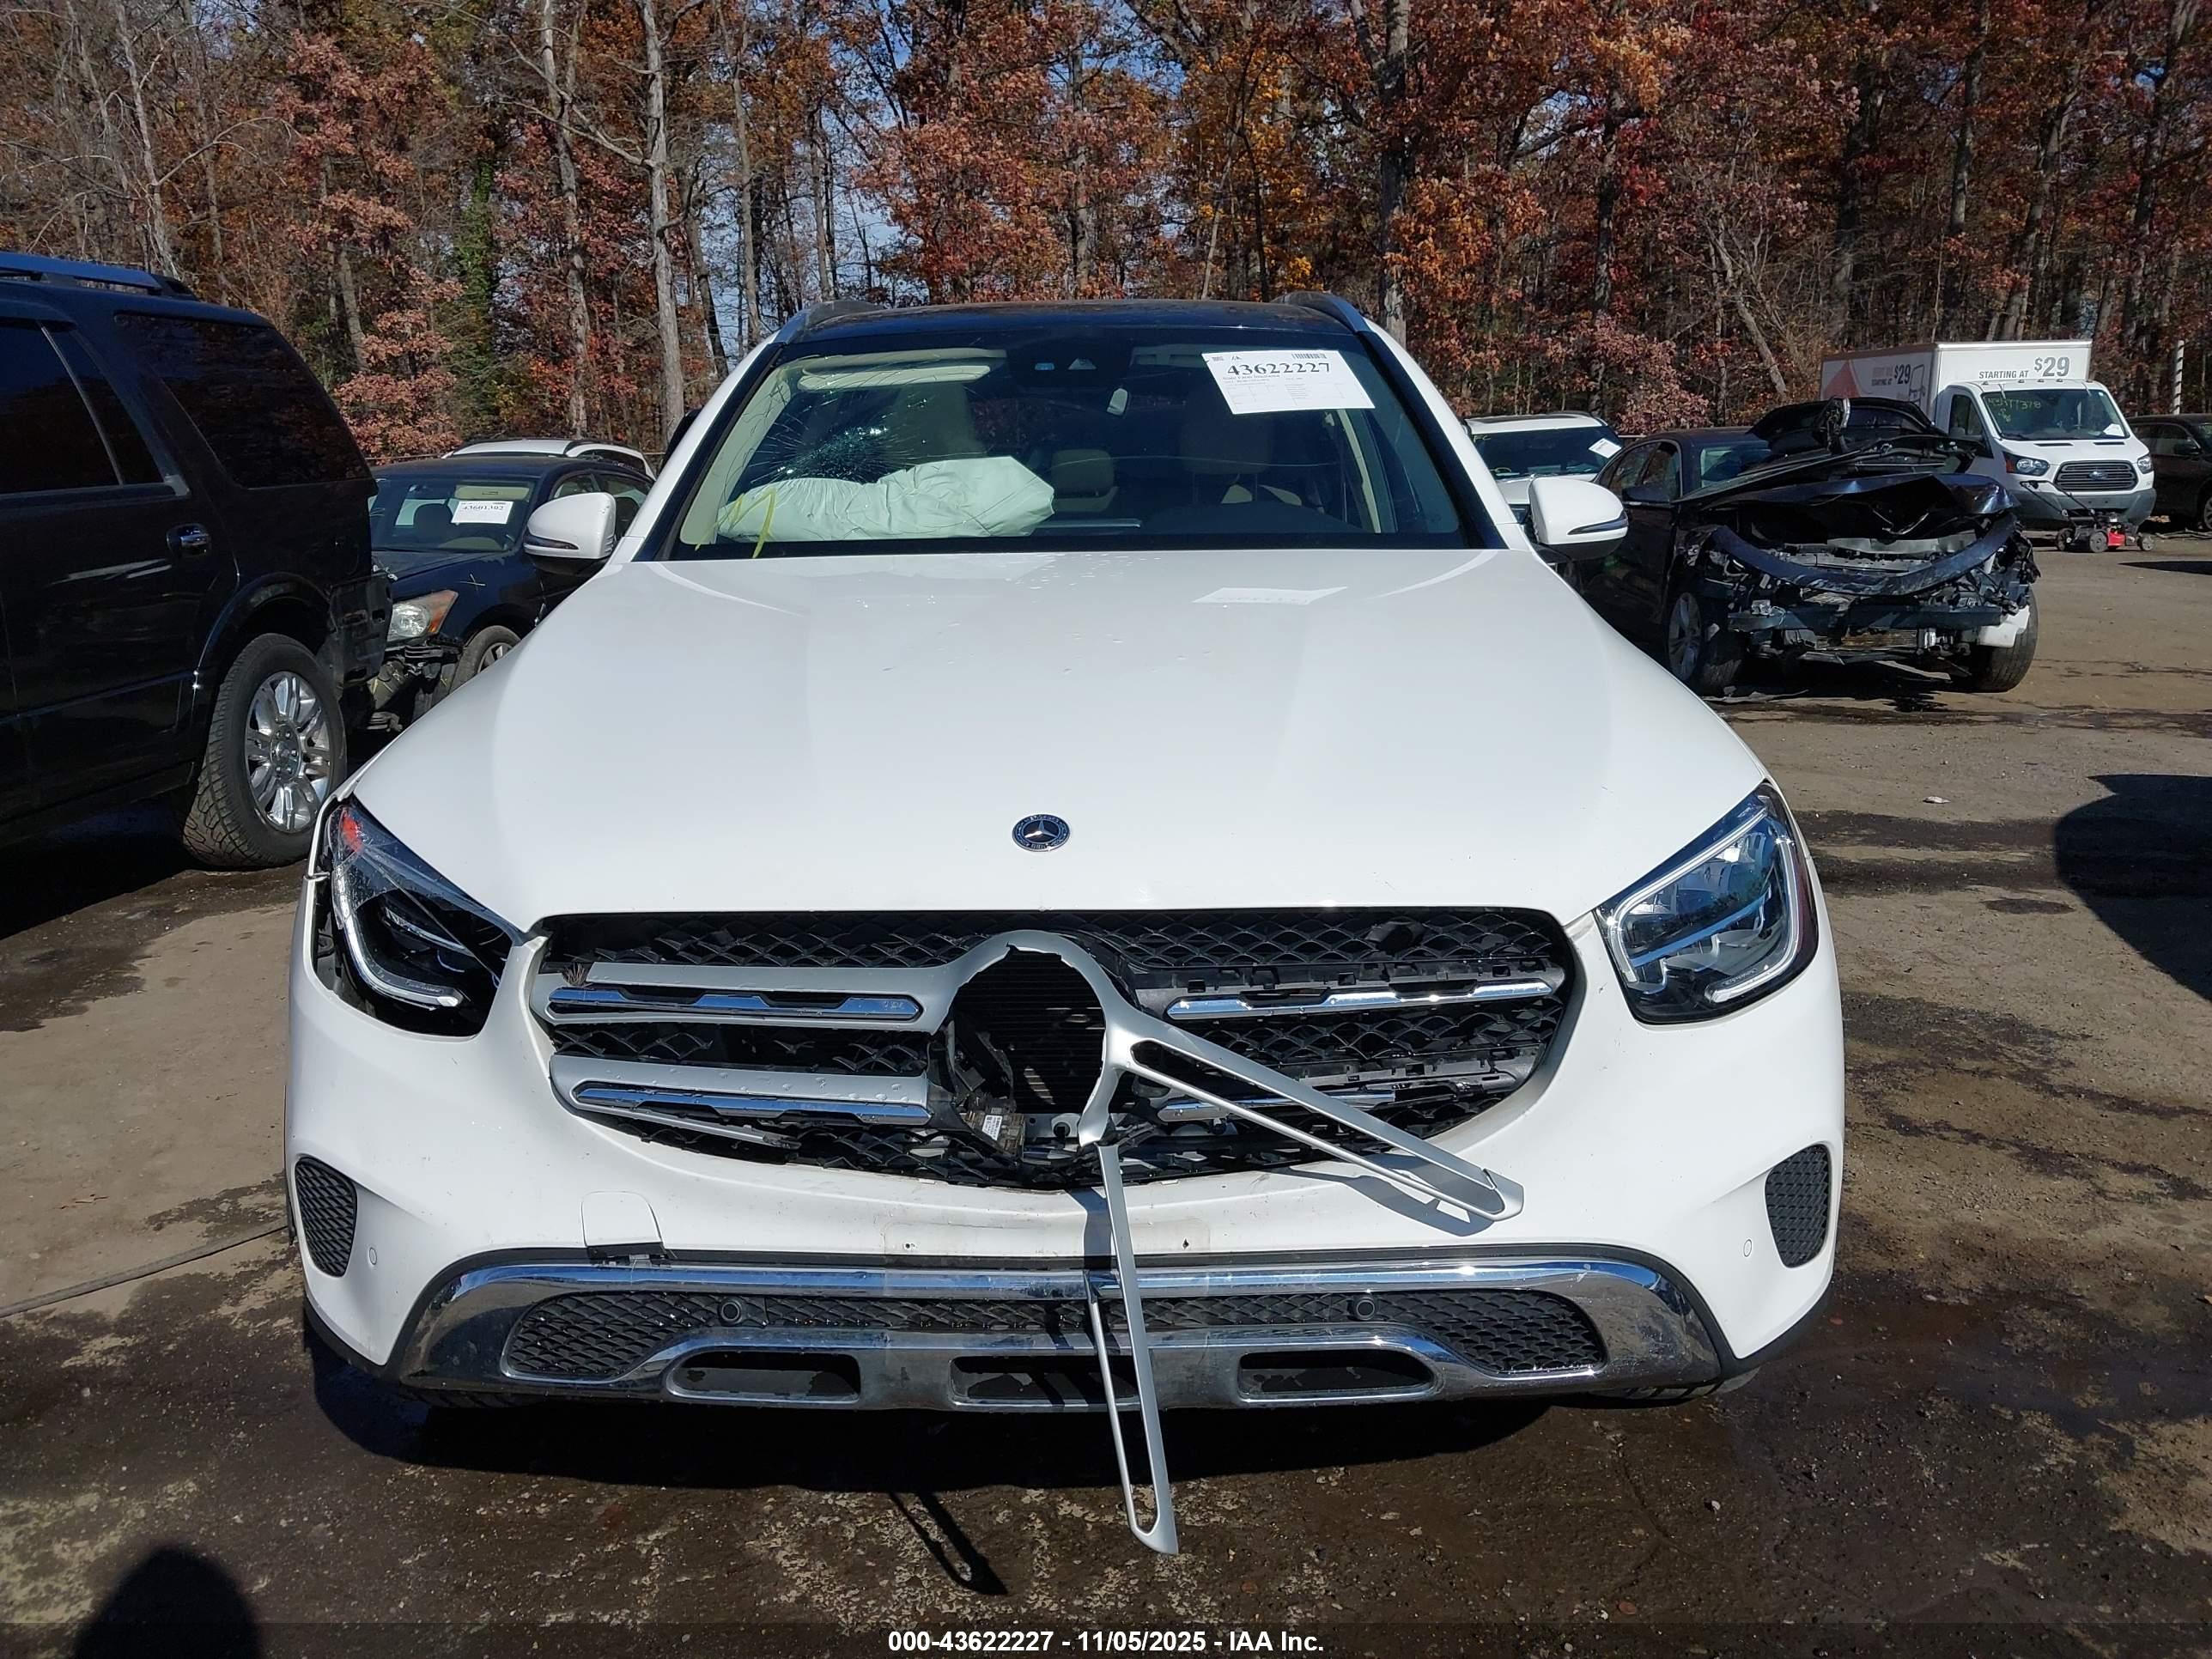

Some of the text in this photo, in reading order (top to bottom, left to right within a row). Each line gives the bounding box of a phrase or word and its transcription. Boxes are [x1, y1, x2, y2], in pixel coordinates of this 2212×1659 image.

[1227, 362, 1330, 375] 43622227
[1893, 363, 1911, 385] $29
[1978, 356, 2070, 379] STARTING AT $29
